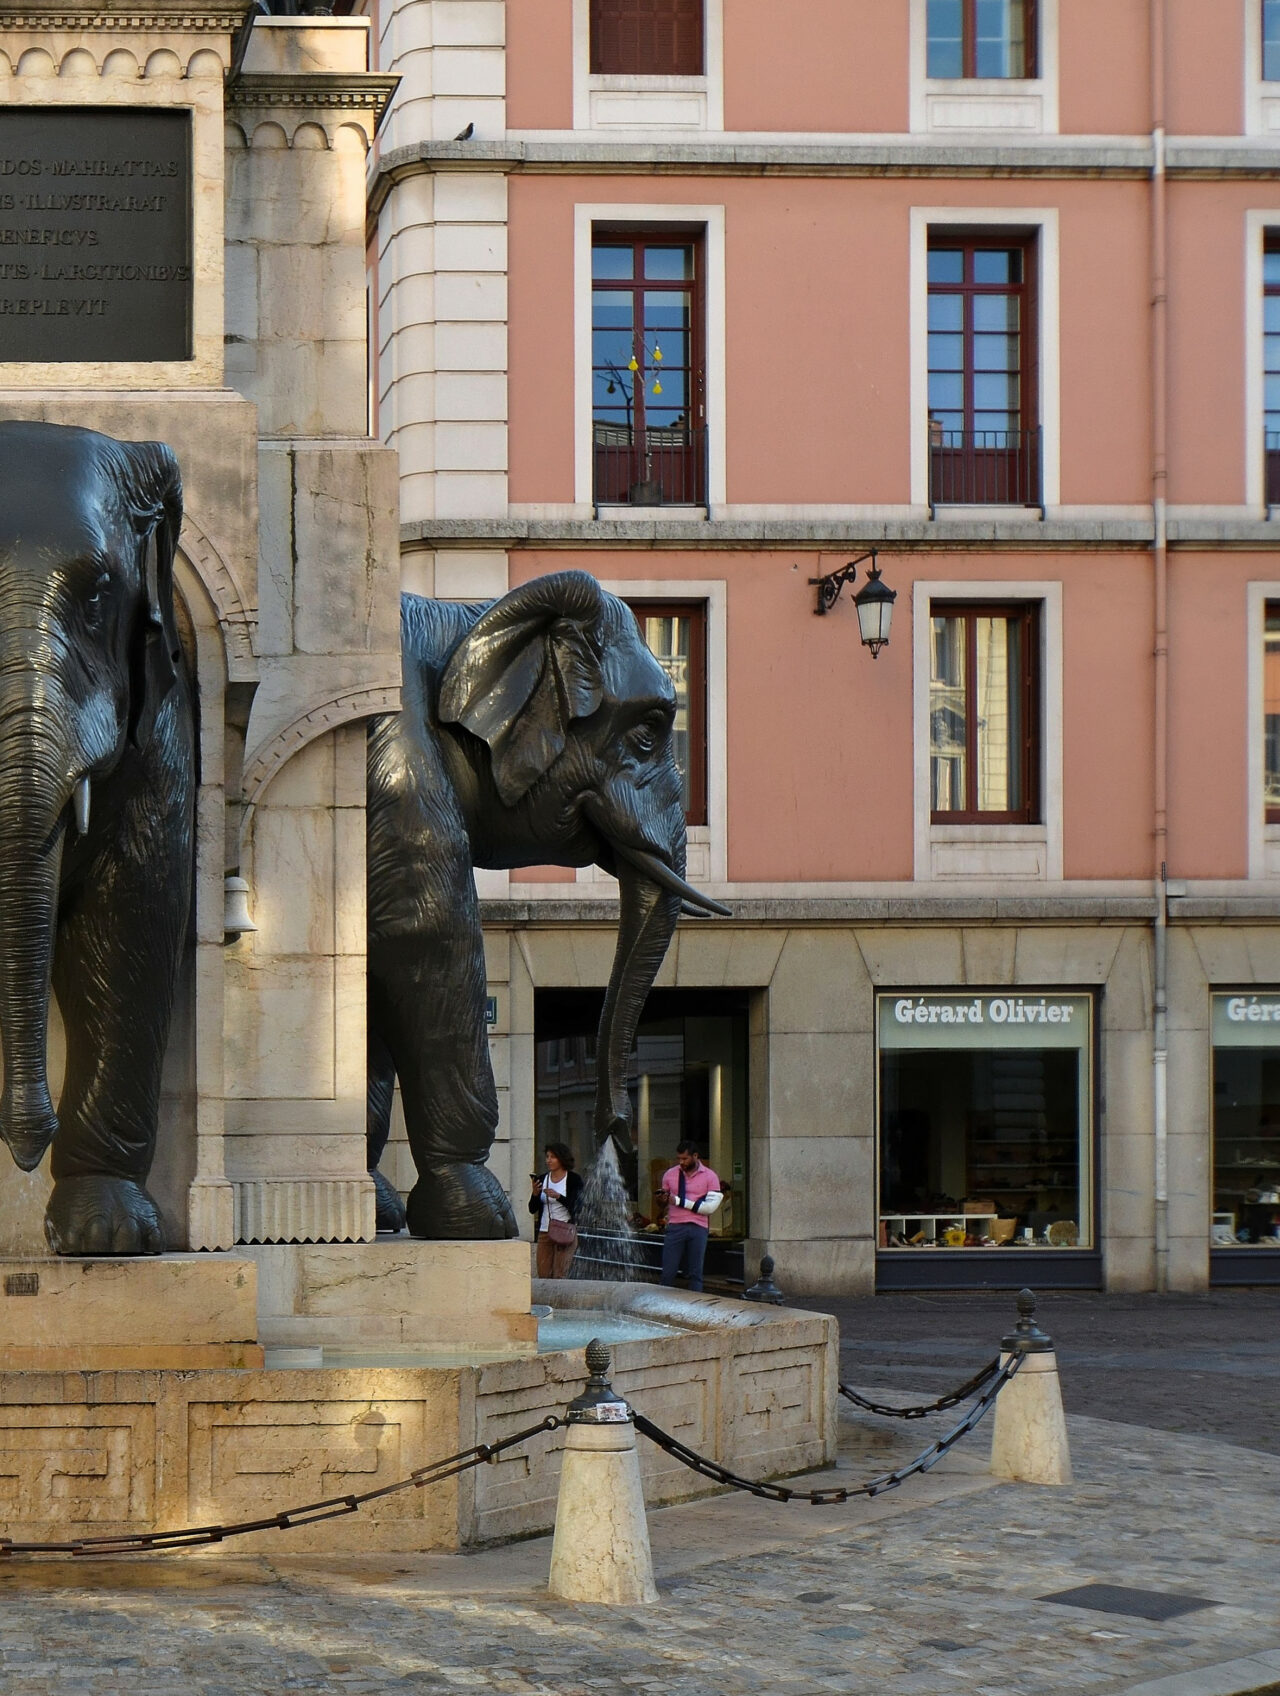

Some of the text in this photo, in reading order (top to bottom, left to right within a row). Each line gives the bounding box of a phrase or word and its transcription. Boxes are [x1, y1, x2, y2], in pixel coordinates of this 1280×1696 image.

[52, 160, 179, 177] MAHRATTAS
[0, 299, 109, 316] REPLEVIT
[894, 997, 1074, 1023] Gérard Olivier
